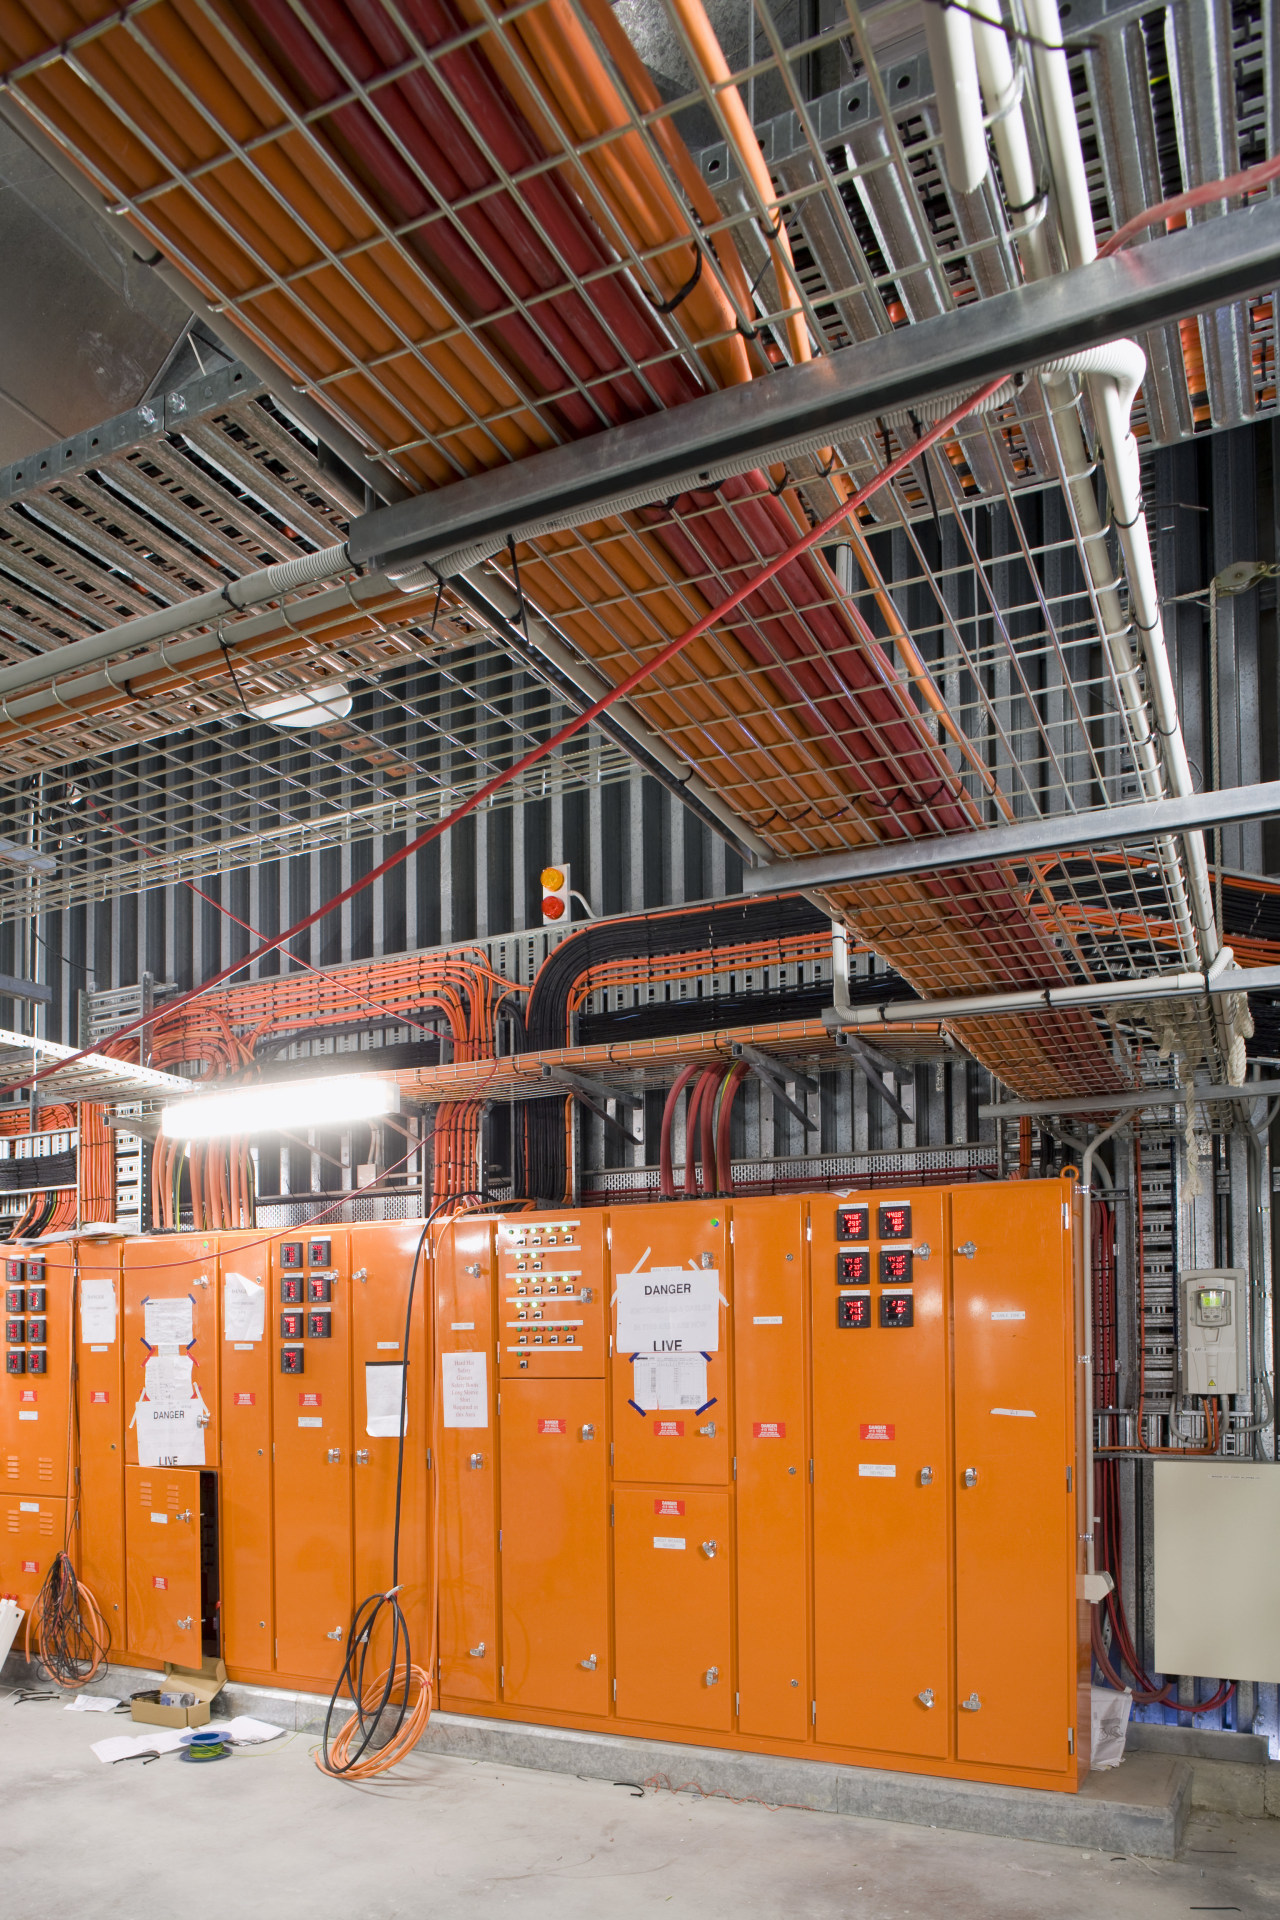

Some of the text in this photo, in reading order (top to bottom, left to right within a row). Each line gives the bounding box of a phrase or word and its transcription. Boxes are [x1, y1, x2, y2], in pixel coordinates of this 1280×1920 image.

[644, 1283, 692, 1296] DANGER
[652, 1339, 683, 1352] LIVE
[153, 1410, 185, 1420] DANGER
[159, 1455, 178, 1465] LIVE
